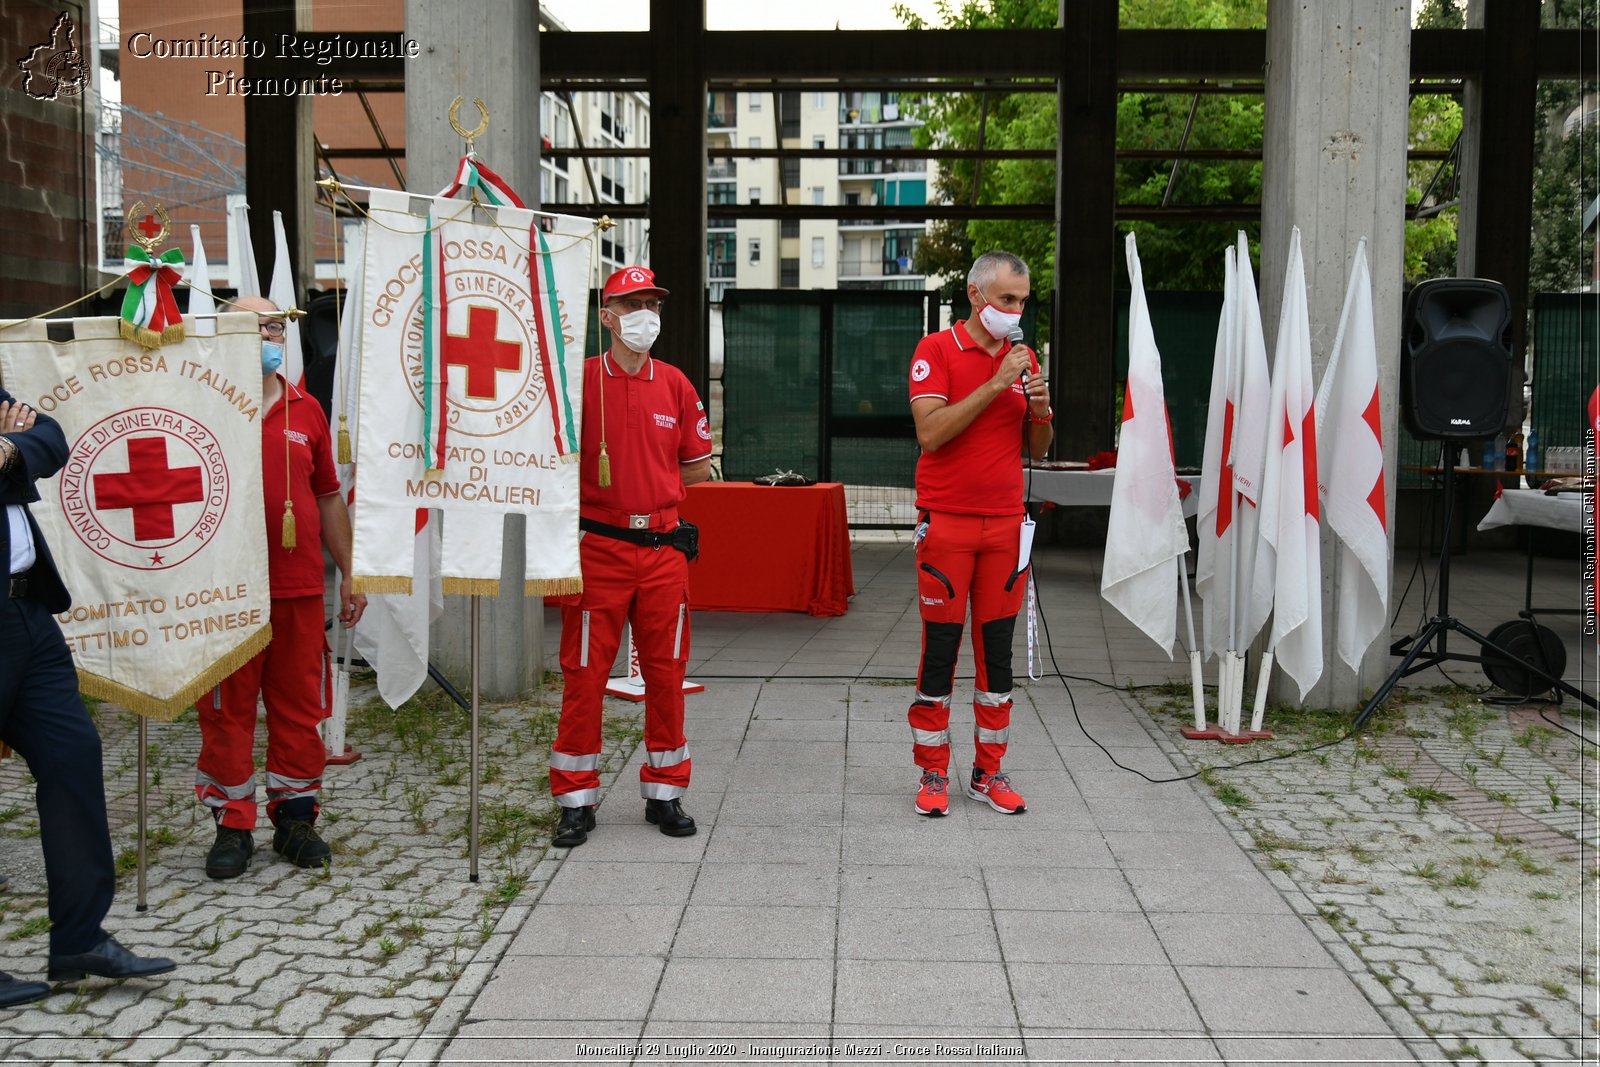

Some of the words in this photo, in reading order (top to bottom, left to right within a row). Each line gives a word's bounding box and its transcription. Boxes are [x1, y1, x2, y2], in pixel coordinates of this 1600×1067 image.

[372, 253, 423, 327] CROCE
[443, 239, 507, 265] OSSA
[455, 276, 526, 312] GINEVRA
[495, 400, 529, 428] 1864
[88, 355, 168, 382] ROSSA
[180, 360, 259, 422] ITALIANA
[91, 427, 111, 445] DI
[111, 413, 183, 433] GINEVRA
[185, 426, 206, 445] 22
[202, 442, 225, 507] AGOSTO
[469, 466, 488, 482] DI
[494, 450, 557, 470] LOCALE
[65, 441, 111, 550] CONVENZIONE
[406, 479, 541, 506] MONCALIERI
[194, 511, 218, 541] 1864
[58, 598, 167, 624] COMITATO
[175, 584, 247, 611] LOCALE
[64, 628, 149, 654] ETTIMO
[159, 608, 261, 643] TORINESE
